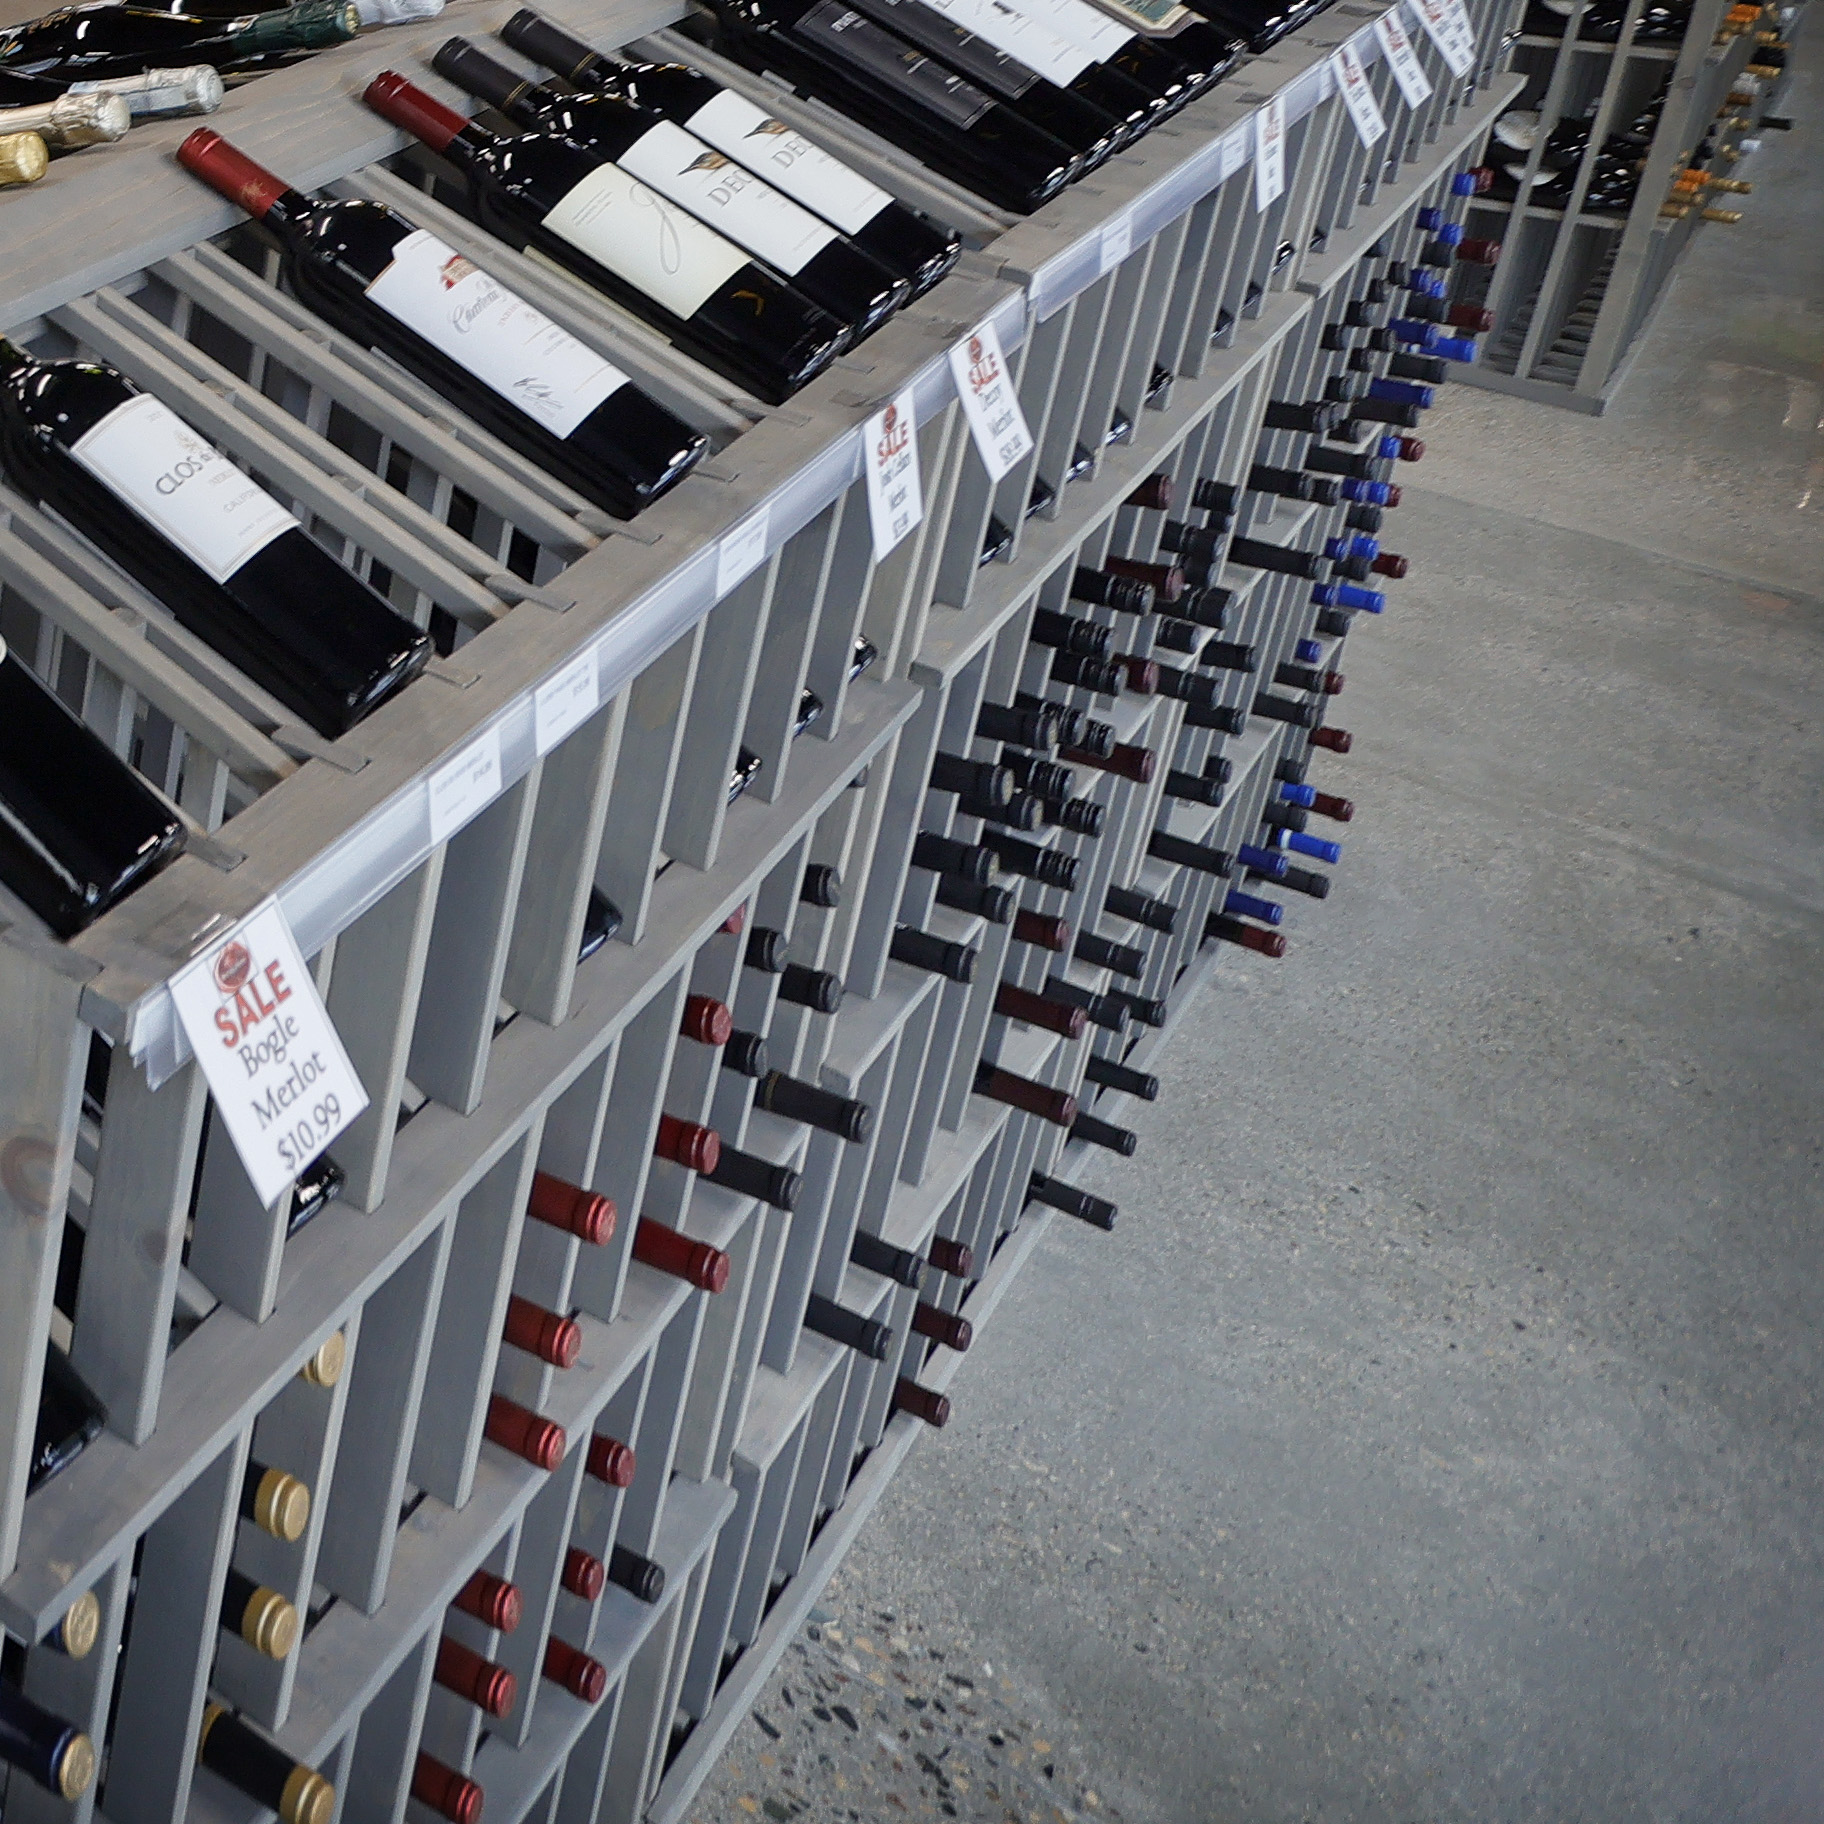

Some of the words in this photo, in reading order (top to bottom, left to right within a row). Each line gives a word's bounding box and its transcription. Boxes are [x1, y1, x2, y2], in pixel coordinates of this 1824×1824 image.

[155, 454, 204, 496] CLOS
[213, 959, 294, 1049] SALE
[237, 1013, 300, 1079] Bogle
[250, 1051, 329, 1131] Merlot
[276, 1092, 343, 1173] $10.99
